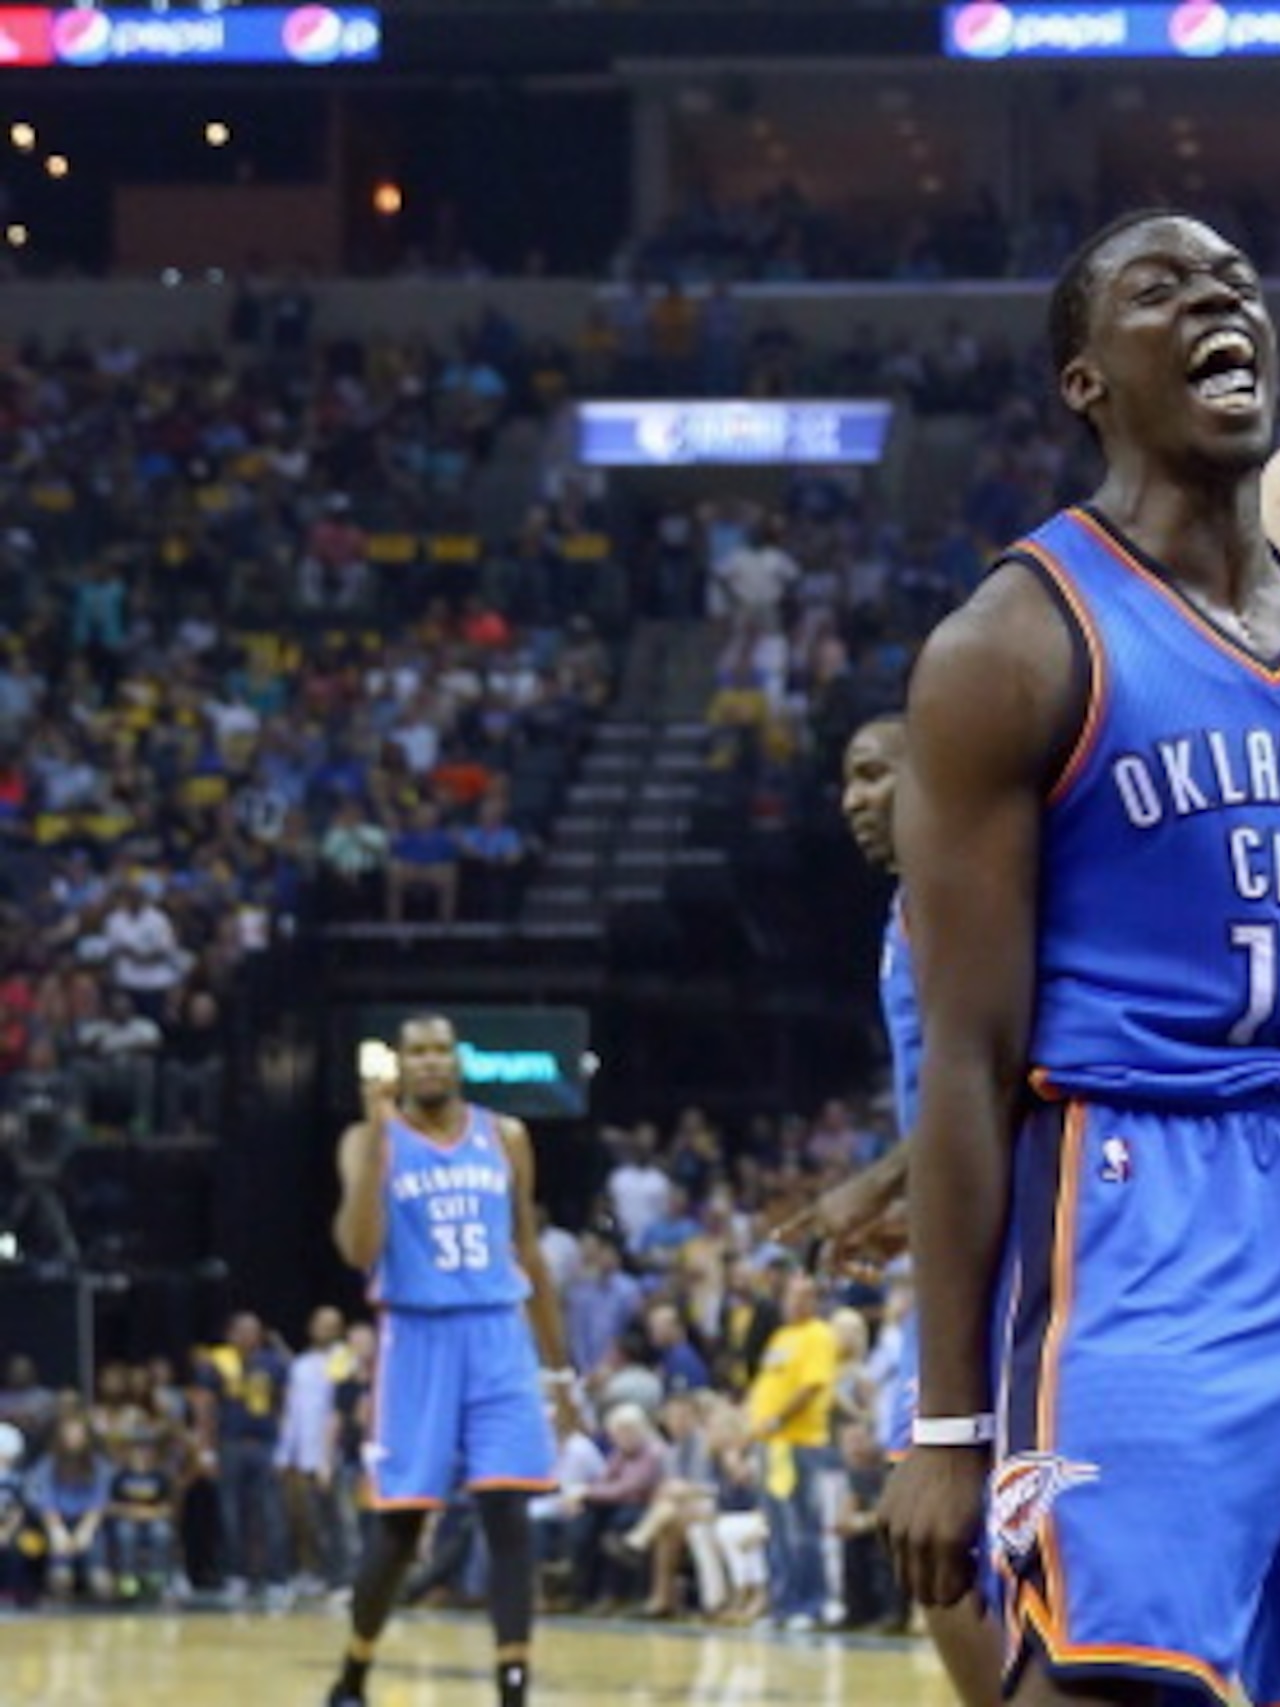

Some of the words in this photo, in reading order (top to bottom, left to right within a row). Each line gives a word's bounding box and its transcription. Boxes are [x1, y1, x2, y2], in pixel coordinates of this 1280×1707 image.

[111, 18, 224, 57] pepsi
[1014, 8, 1126, 50] pepsi
[431, 1222, 489, 1271] 35
